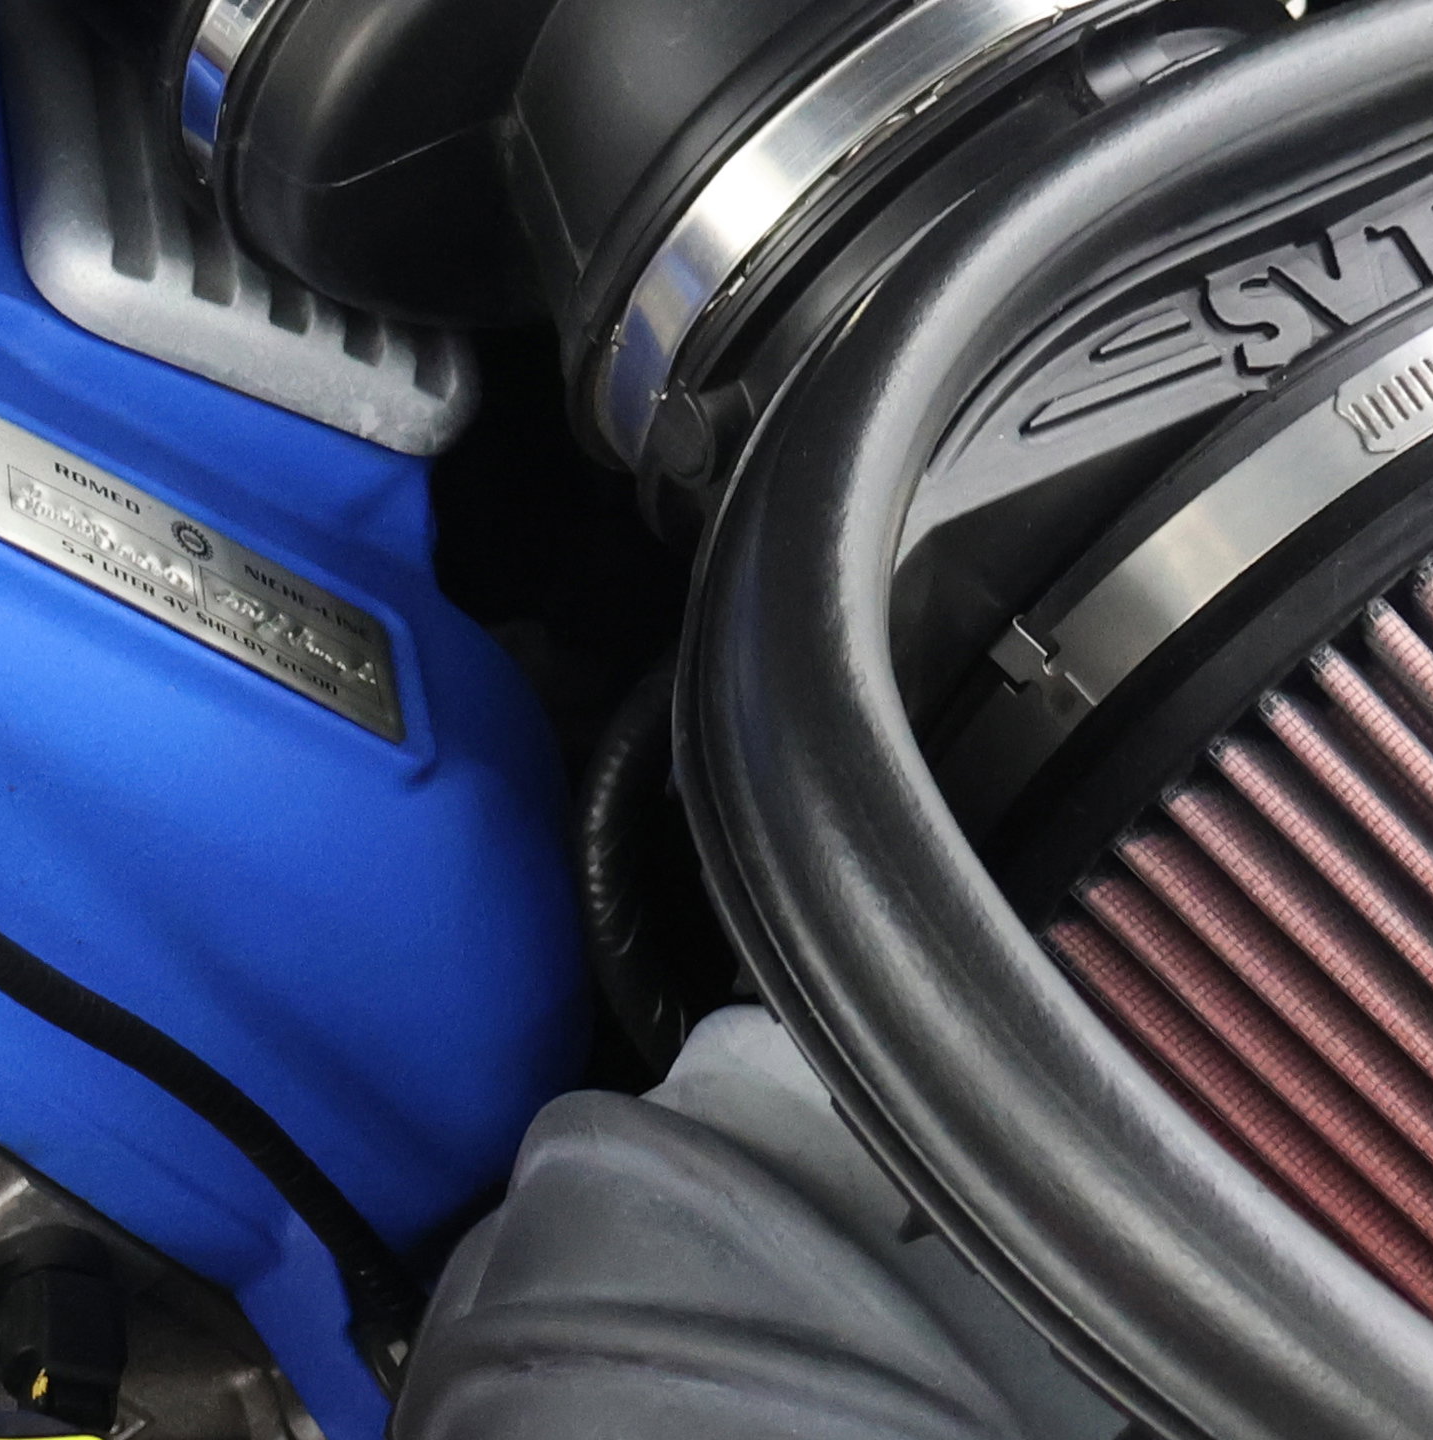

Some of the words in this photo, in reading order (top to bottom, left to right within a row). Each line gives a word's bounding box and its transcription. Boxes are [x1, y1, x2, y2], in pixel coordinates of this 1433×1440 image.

[53, 461, 142, 516] ROMEO
[60, 538, 95, 565] 5.4
[102, 560, 156, 597] LITER
[162, 594, 190, 614] 4V
[195, 610, 270, 657] SHELBY
